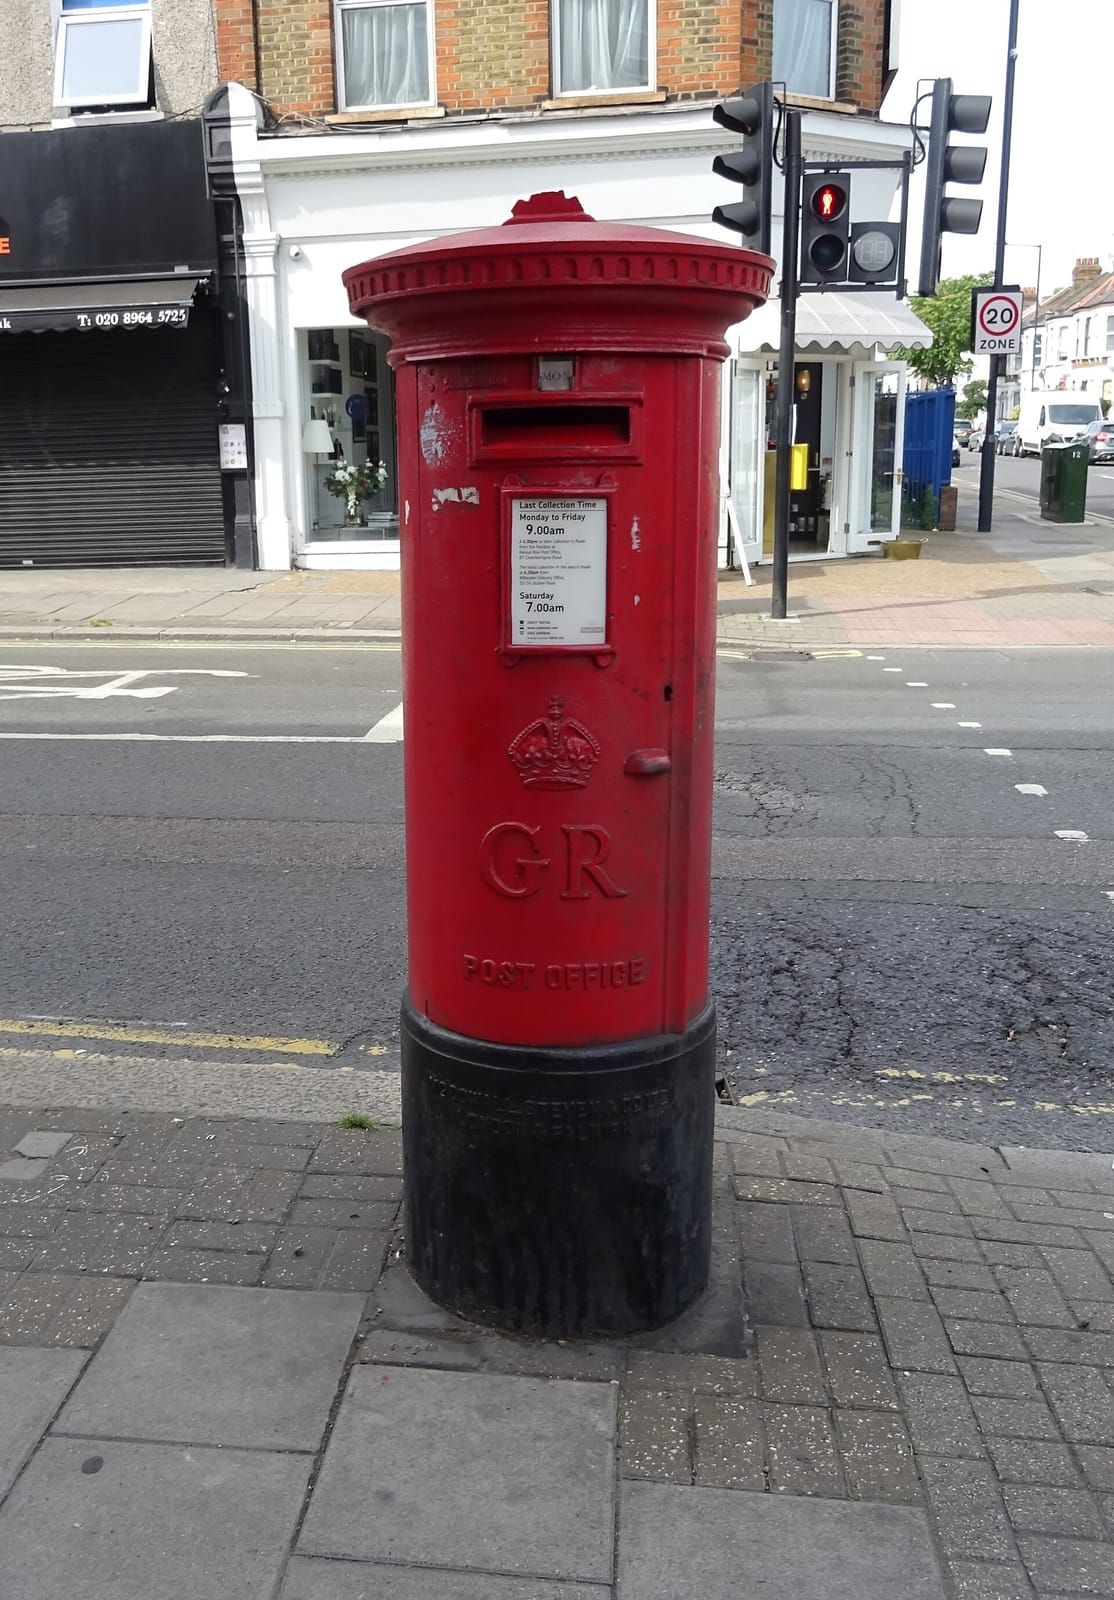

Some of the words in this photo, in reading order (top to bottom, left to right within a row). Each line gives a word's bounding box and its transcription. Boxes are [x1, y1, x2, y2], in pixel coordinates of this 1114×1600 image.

[95, 313, 119, 326] 020
[123, 311, 153, 324] 8964
[157, 309, 186, 322] 5725
[986, 308, 1013, 324] 20
[980, 339, 1015, 350] ZONE
[519, 501, 536, 509] Last
[538, 501, 575, 509] Collection
[577, 500, 597, 509] Time
[519, 513, 550, 522] Monday
[562, 513, 586, 522] Friday
[526, 524, 565, 535] 9.00am
[519, 592, 554, 600] Saturday
[526, 601, 564, 612] 7.00am
[463, 954, 535, 990] POST
[546, 957, 646, 991] OFFICE
